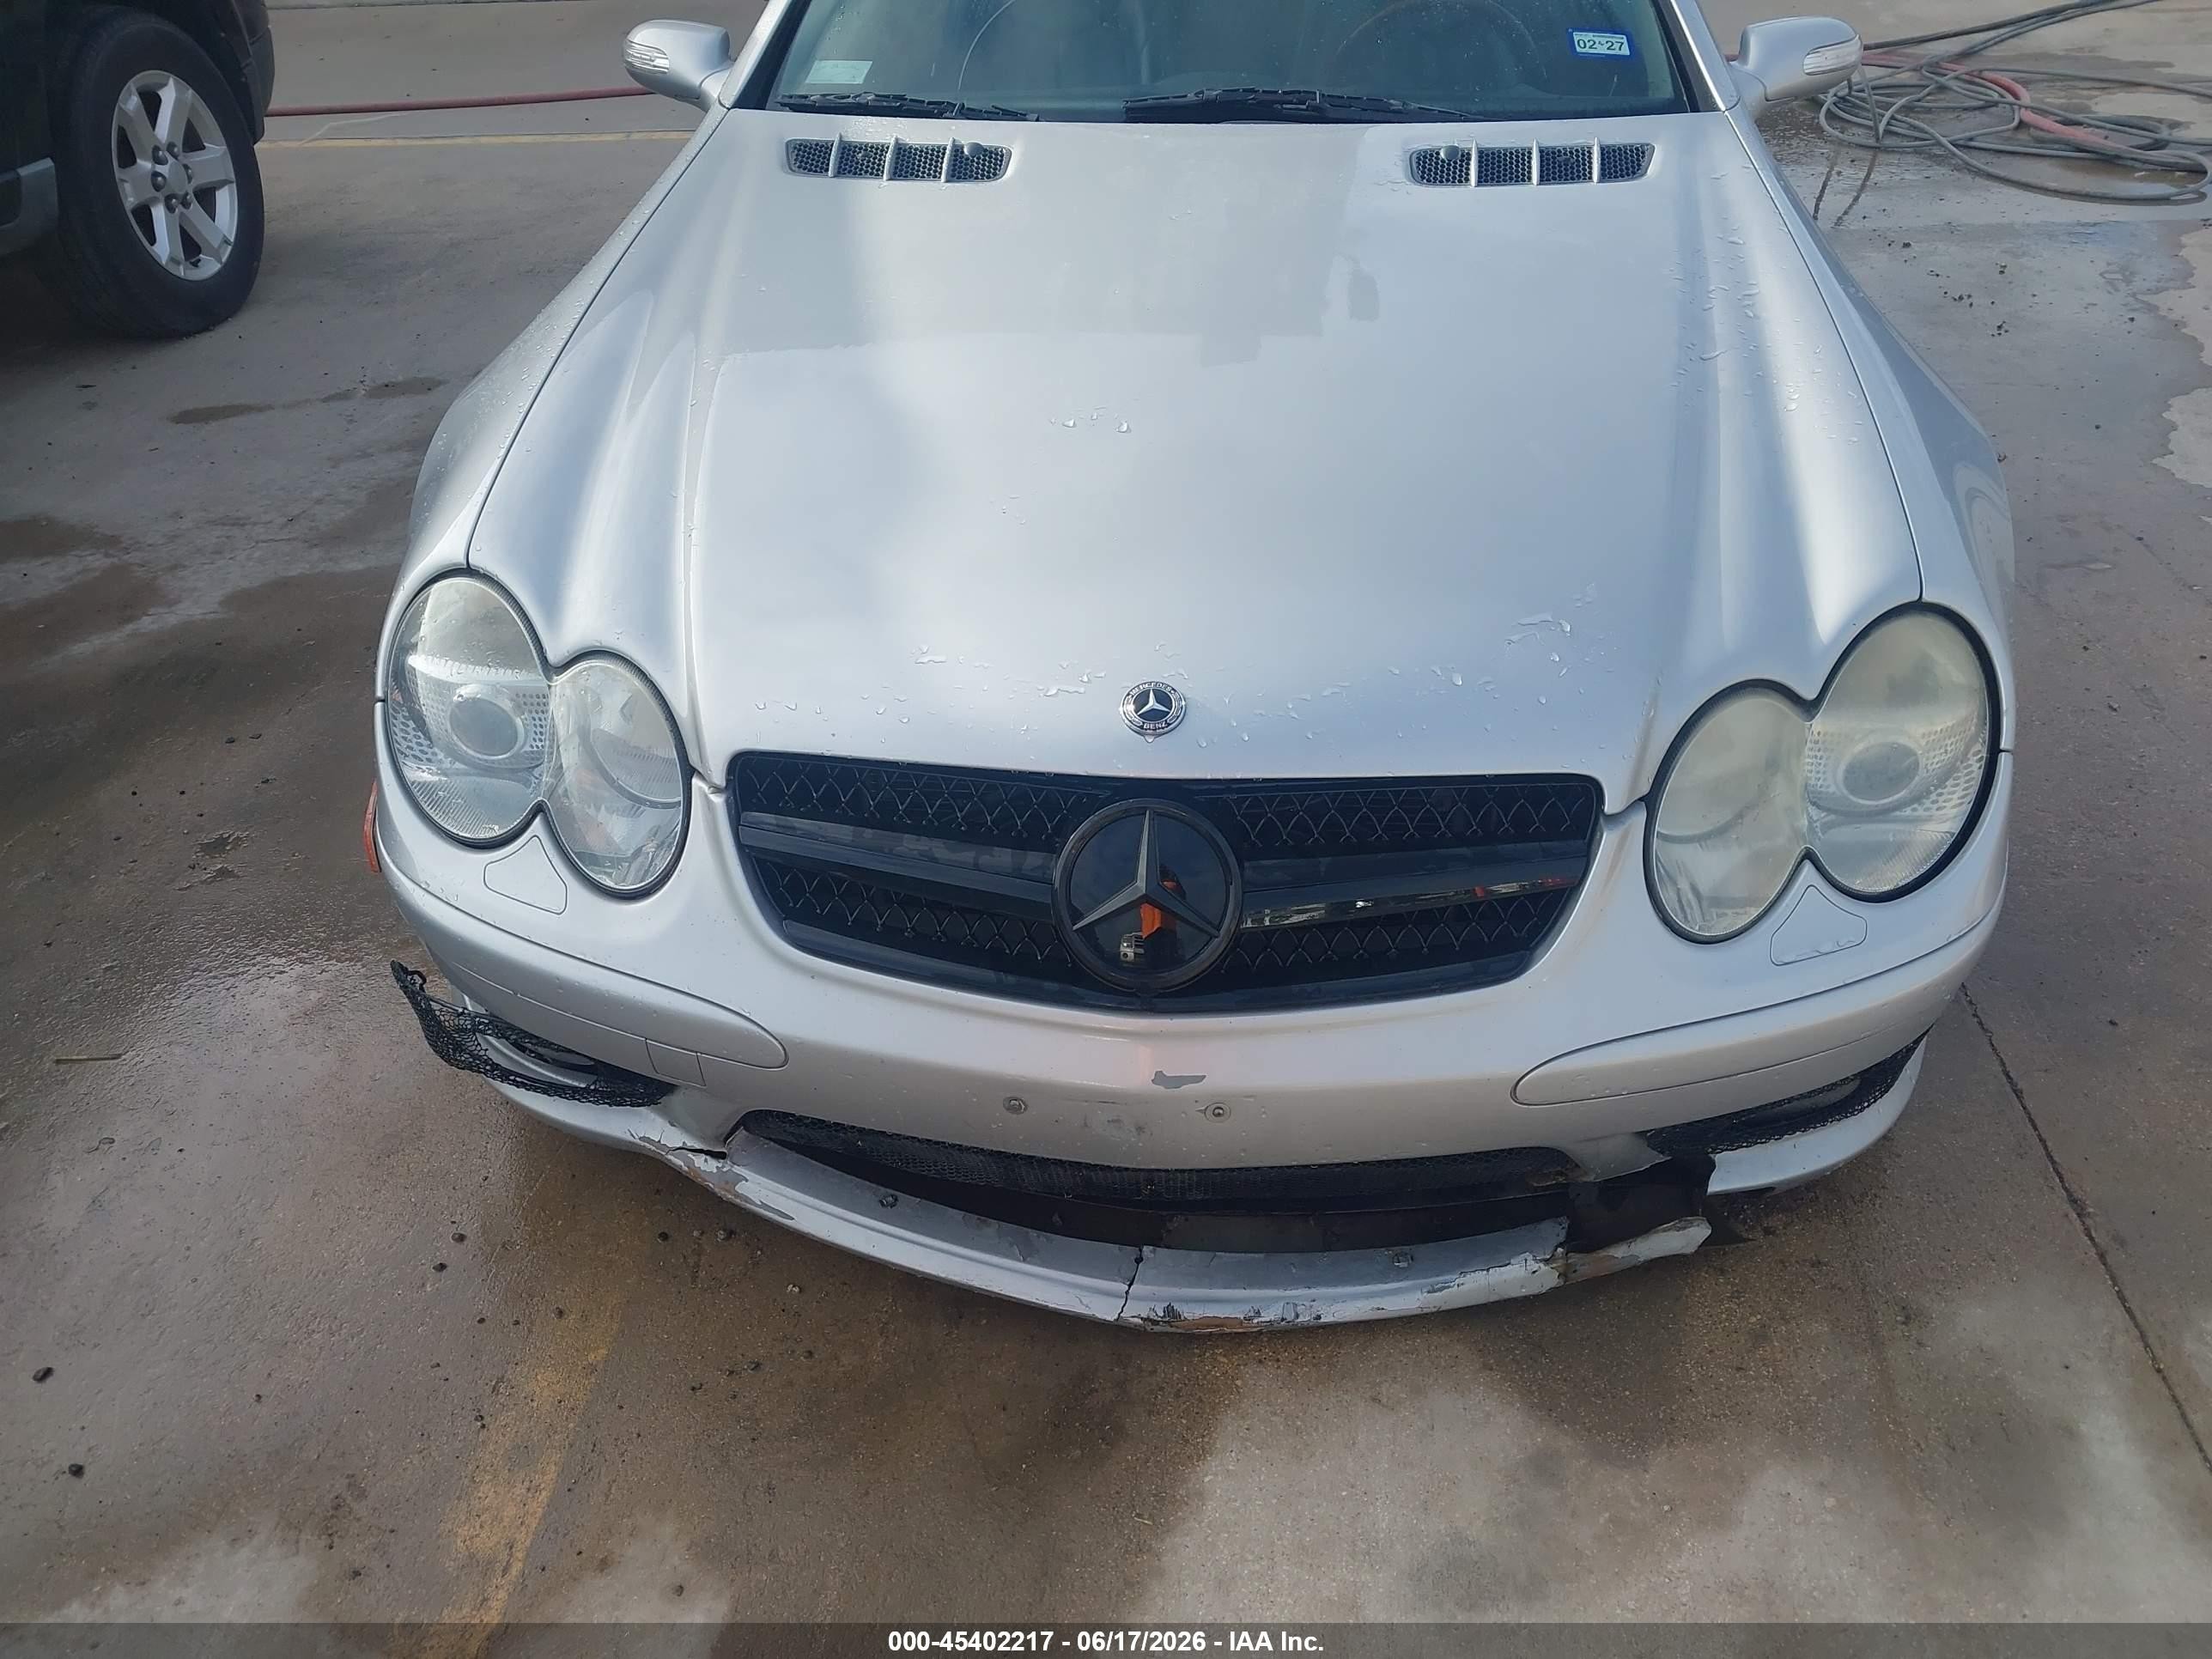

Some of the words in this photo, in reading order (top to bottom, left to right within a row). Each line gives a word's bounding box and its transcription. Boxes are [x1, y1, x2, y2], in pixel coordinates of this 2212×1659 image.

[1577, 39, 1597, 50] 02
[1605, 40, 1625, 52] 27
[1143, 721, 1169, 730] BENZ
